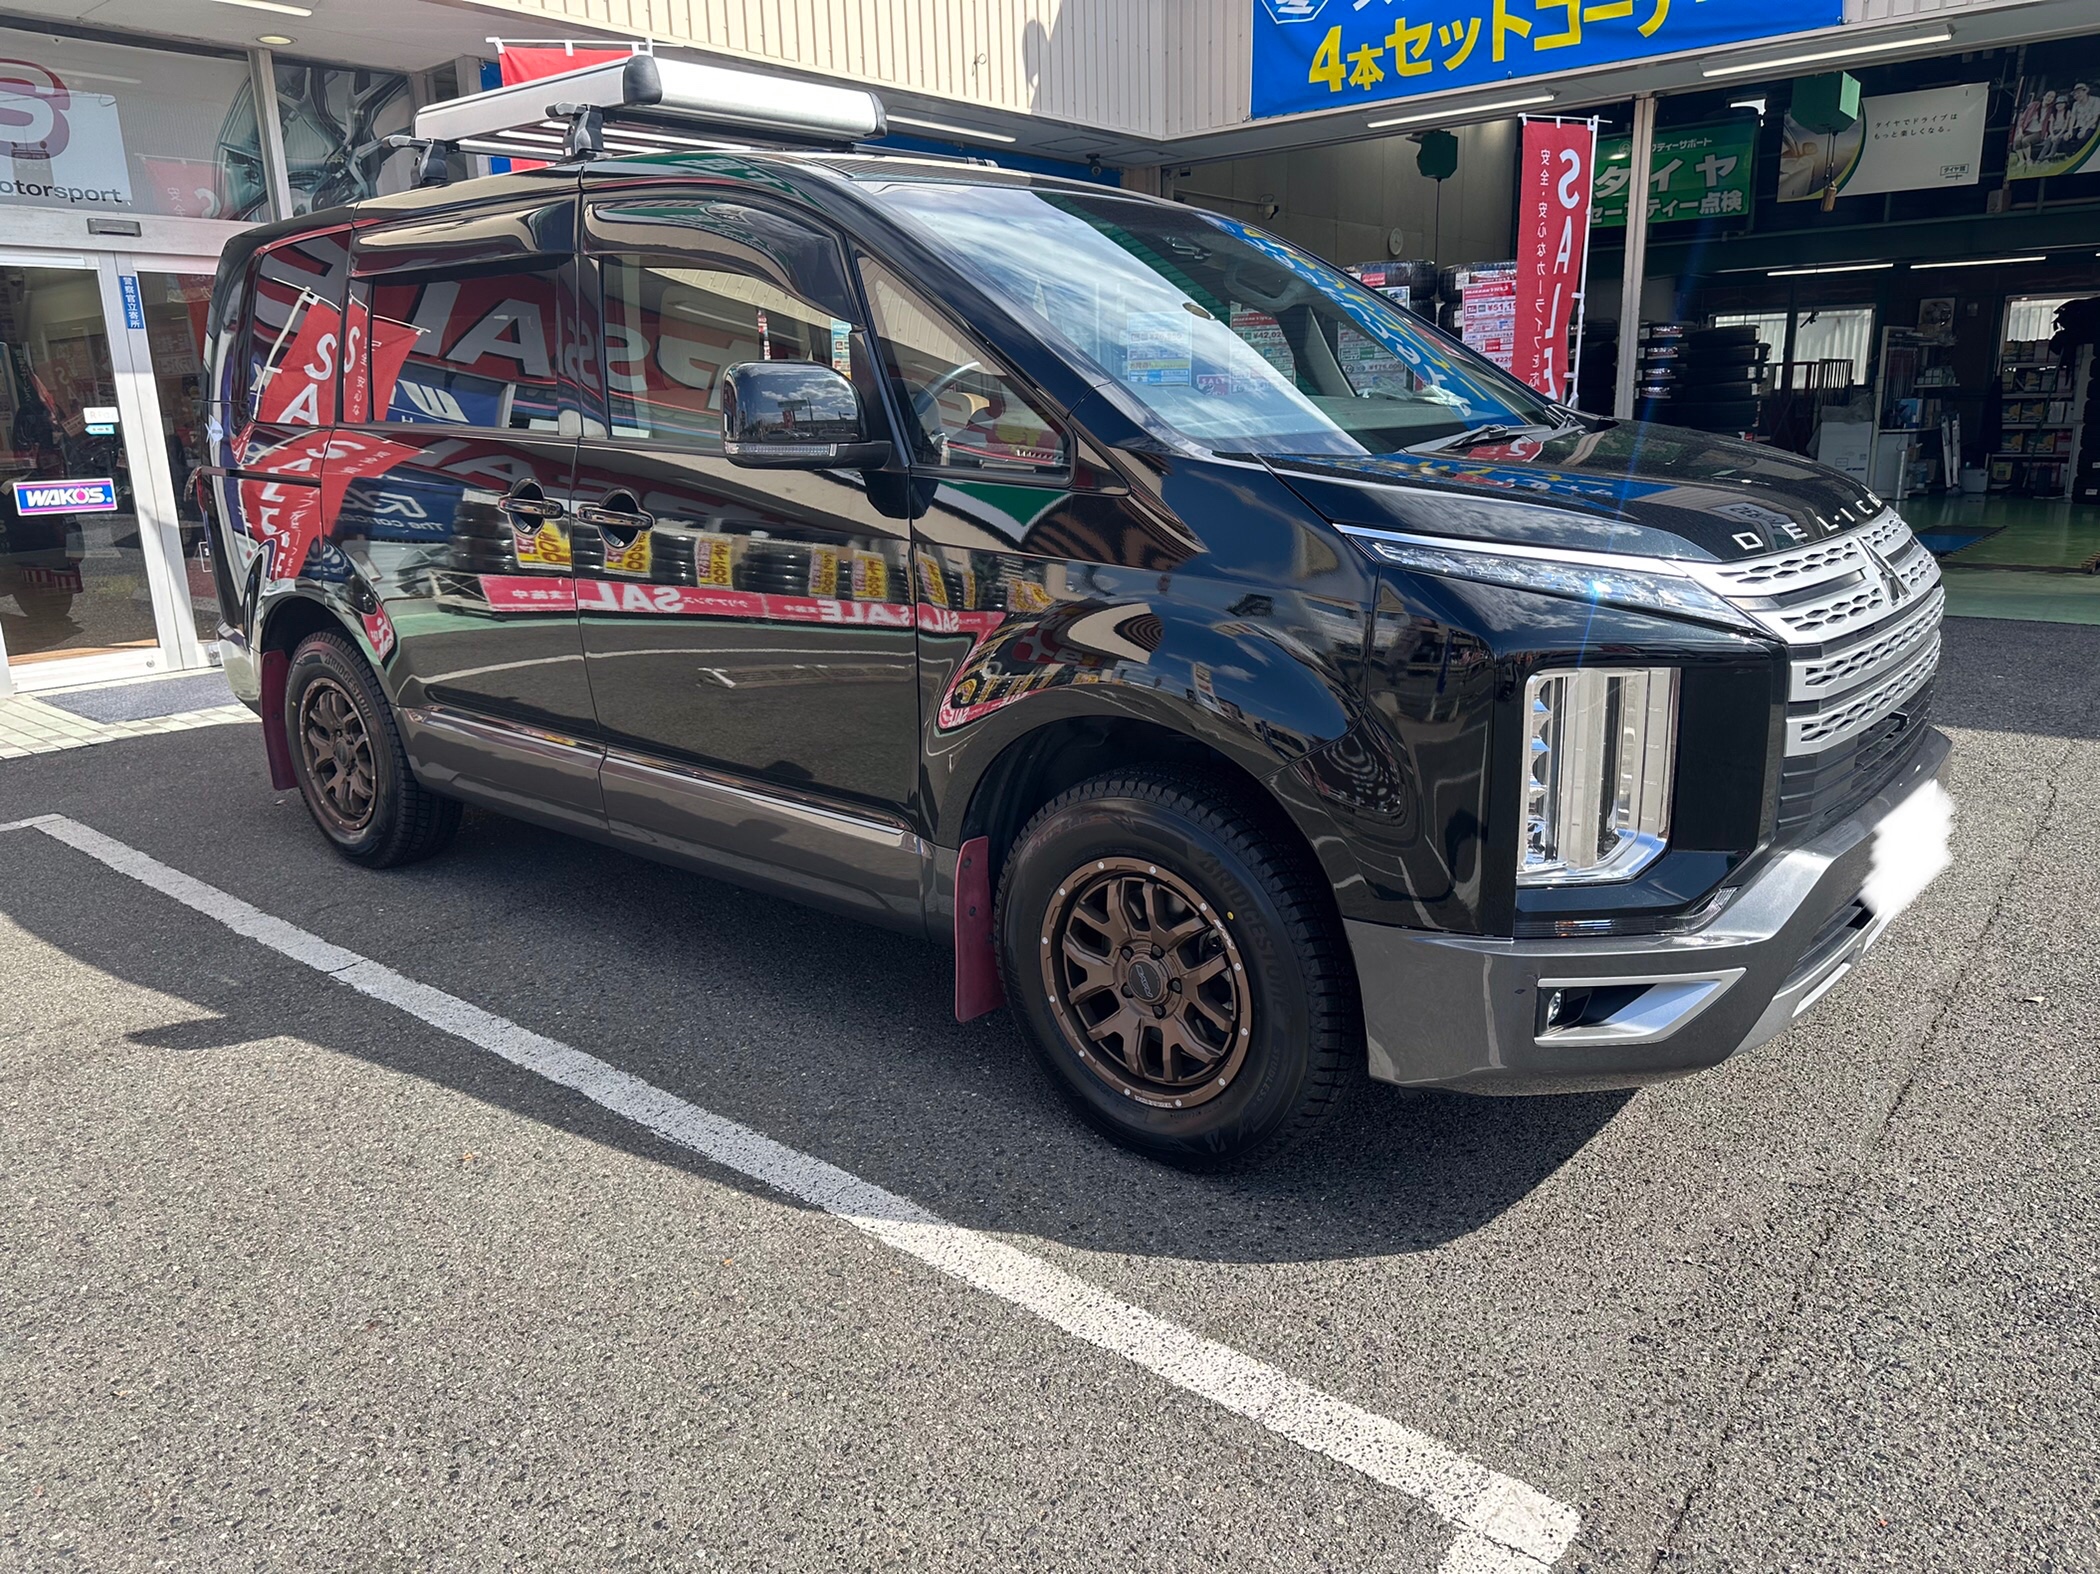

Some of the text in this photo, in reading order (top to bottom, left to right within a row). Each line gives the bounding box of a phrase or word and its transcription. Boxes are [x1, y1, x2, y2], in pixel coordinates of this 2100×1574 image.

[1874, 113, 1958, 129] タイヤでドライブは
[1874, 125, 1951, 140] もっと楽しくなる。
[1594, 154, 1738, 198] タイヤ
[1590, 190, 1742, 222] セーティー点検
[123, 276, 141, 329] 警察官立寄所
[1253, 330, 1287, 340] ¥42,02
